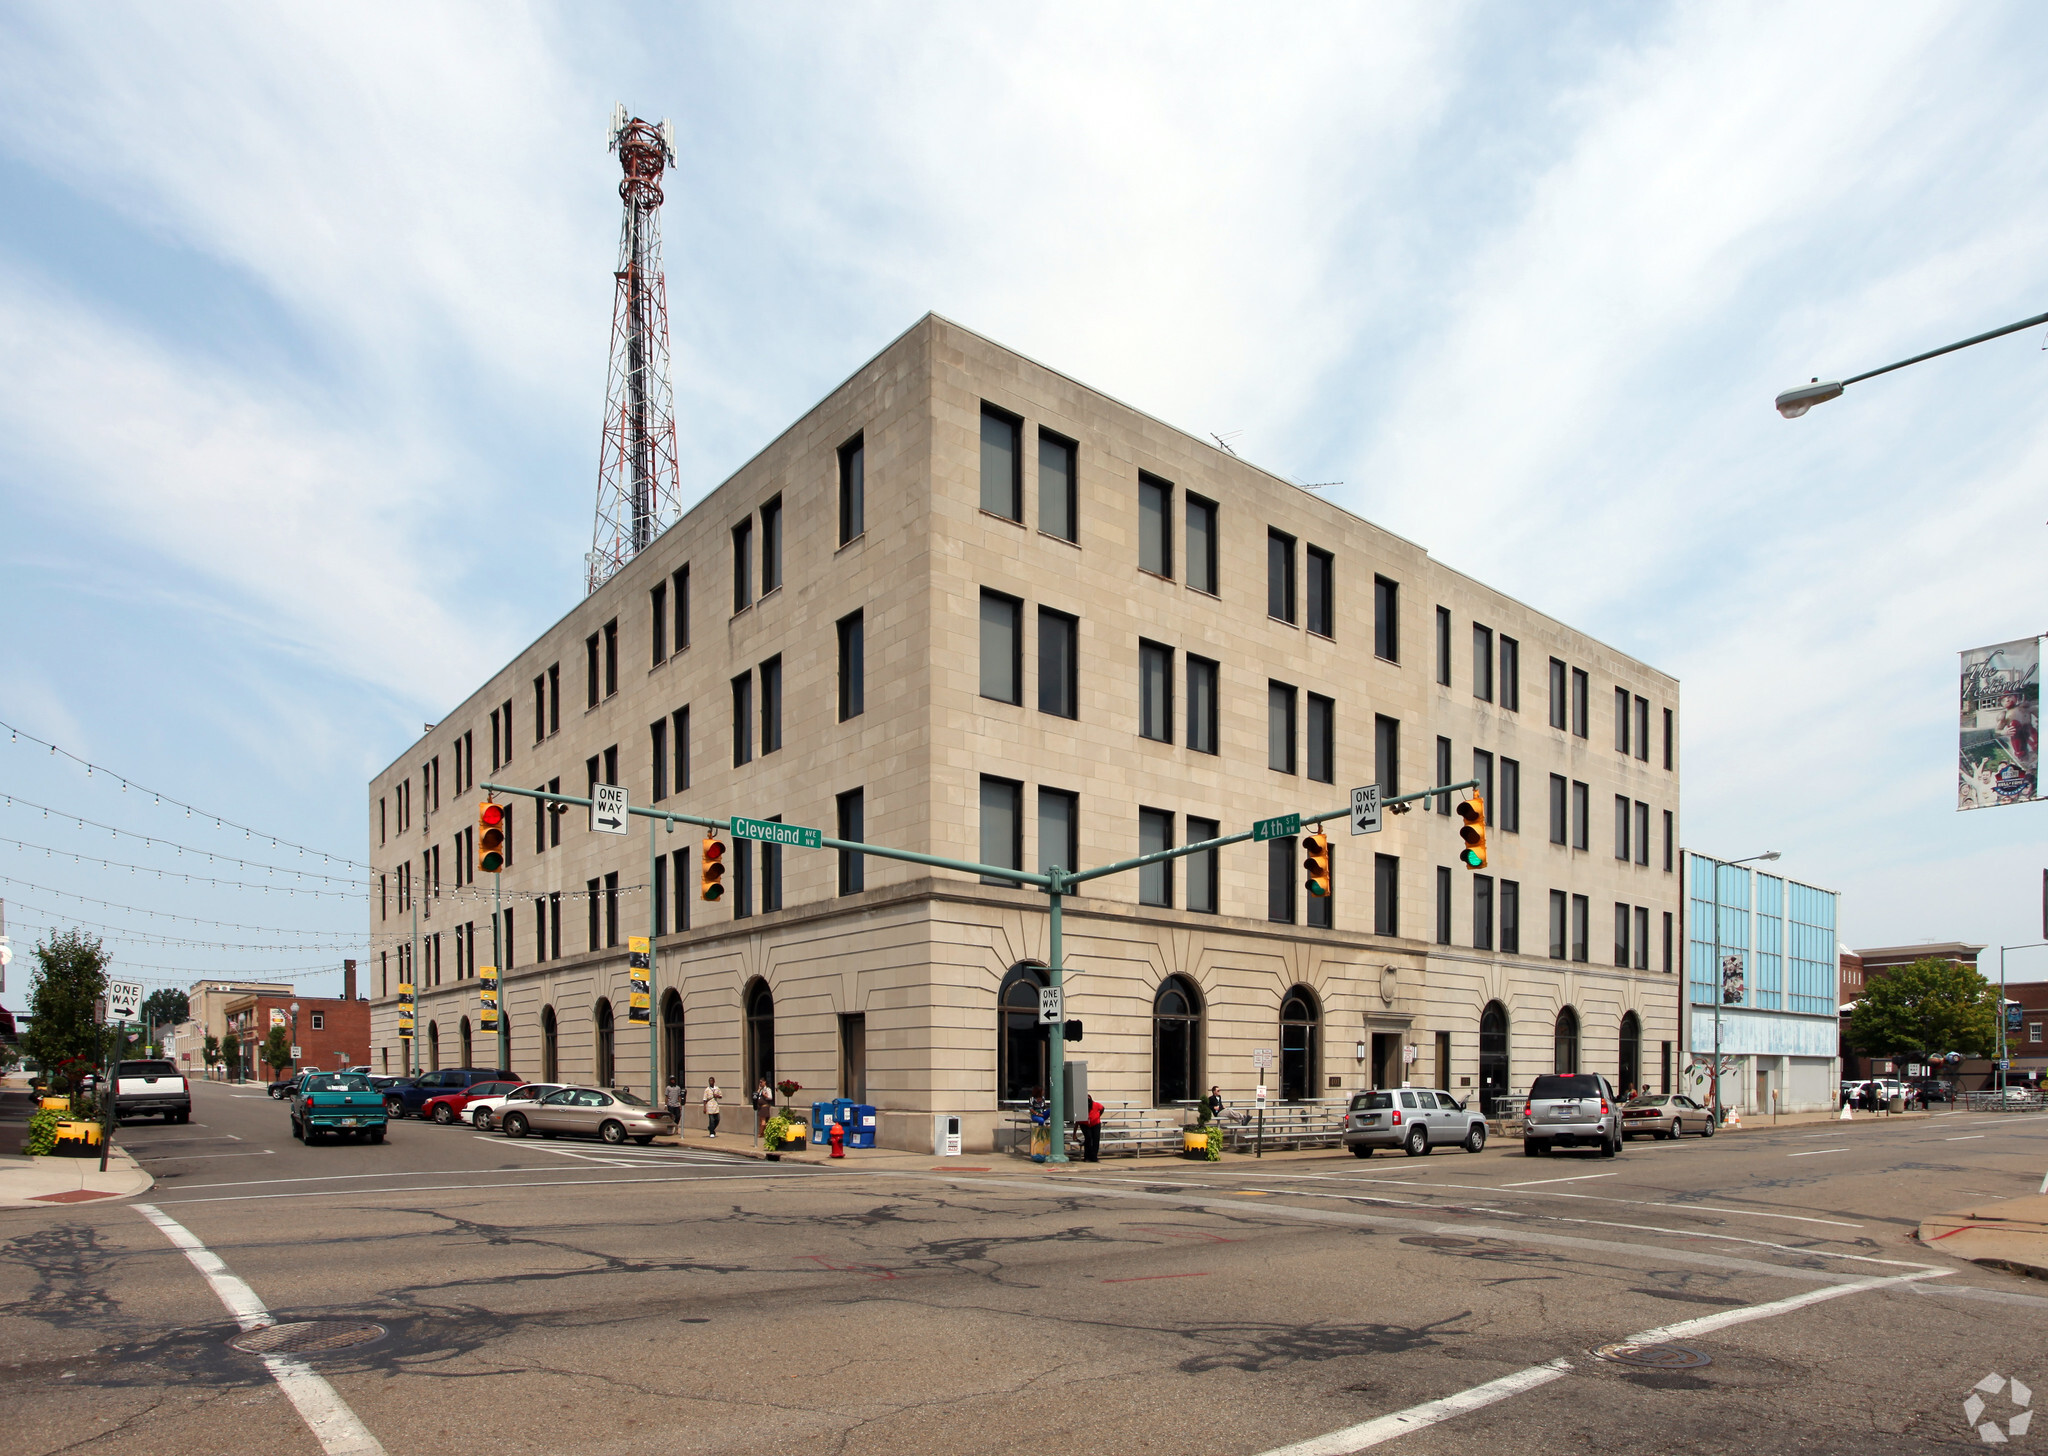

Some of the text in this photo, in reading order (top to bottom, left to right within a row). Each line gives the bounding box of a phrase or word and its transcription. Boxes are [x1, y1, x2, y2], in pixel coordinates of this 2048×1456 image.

[1965, 650, 2004, 680] The
[600, 788, 622, 802] ONE
[1355, 789, 1376, 802] ONE
[598, 801, 622, 814] WAY
[1355, 802, 1377, 815] WAY
[736, 819, 816, 844] Cleveland AVE
[1260, 816, 1295, 838] 4th ST
[1286, 825, 1295, 833] NW
[805, 838, 815, 846] NW
[113, 984, 139, 996] ONE
[1043, 990, 1058, 998] ONE
[112, 995, 138, 1006] WAY
[1043, 1000, 1058, 1008] WAY
